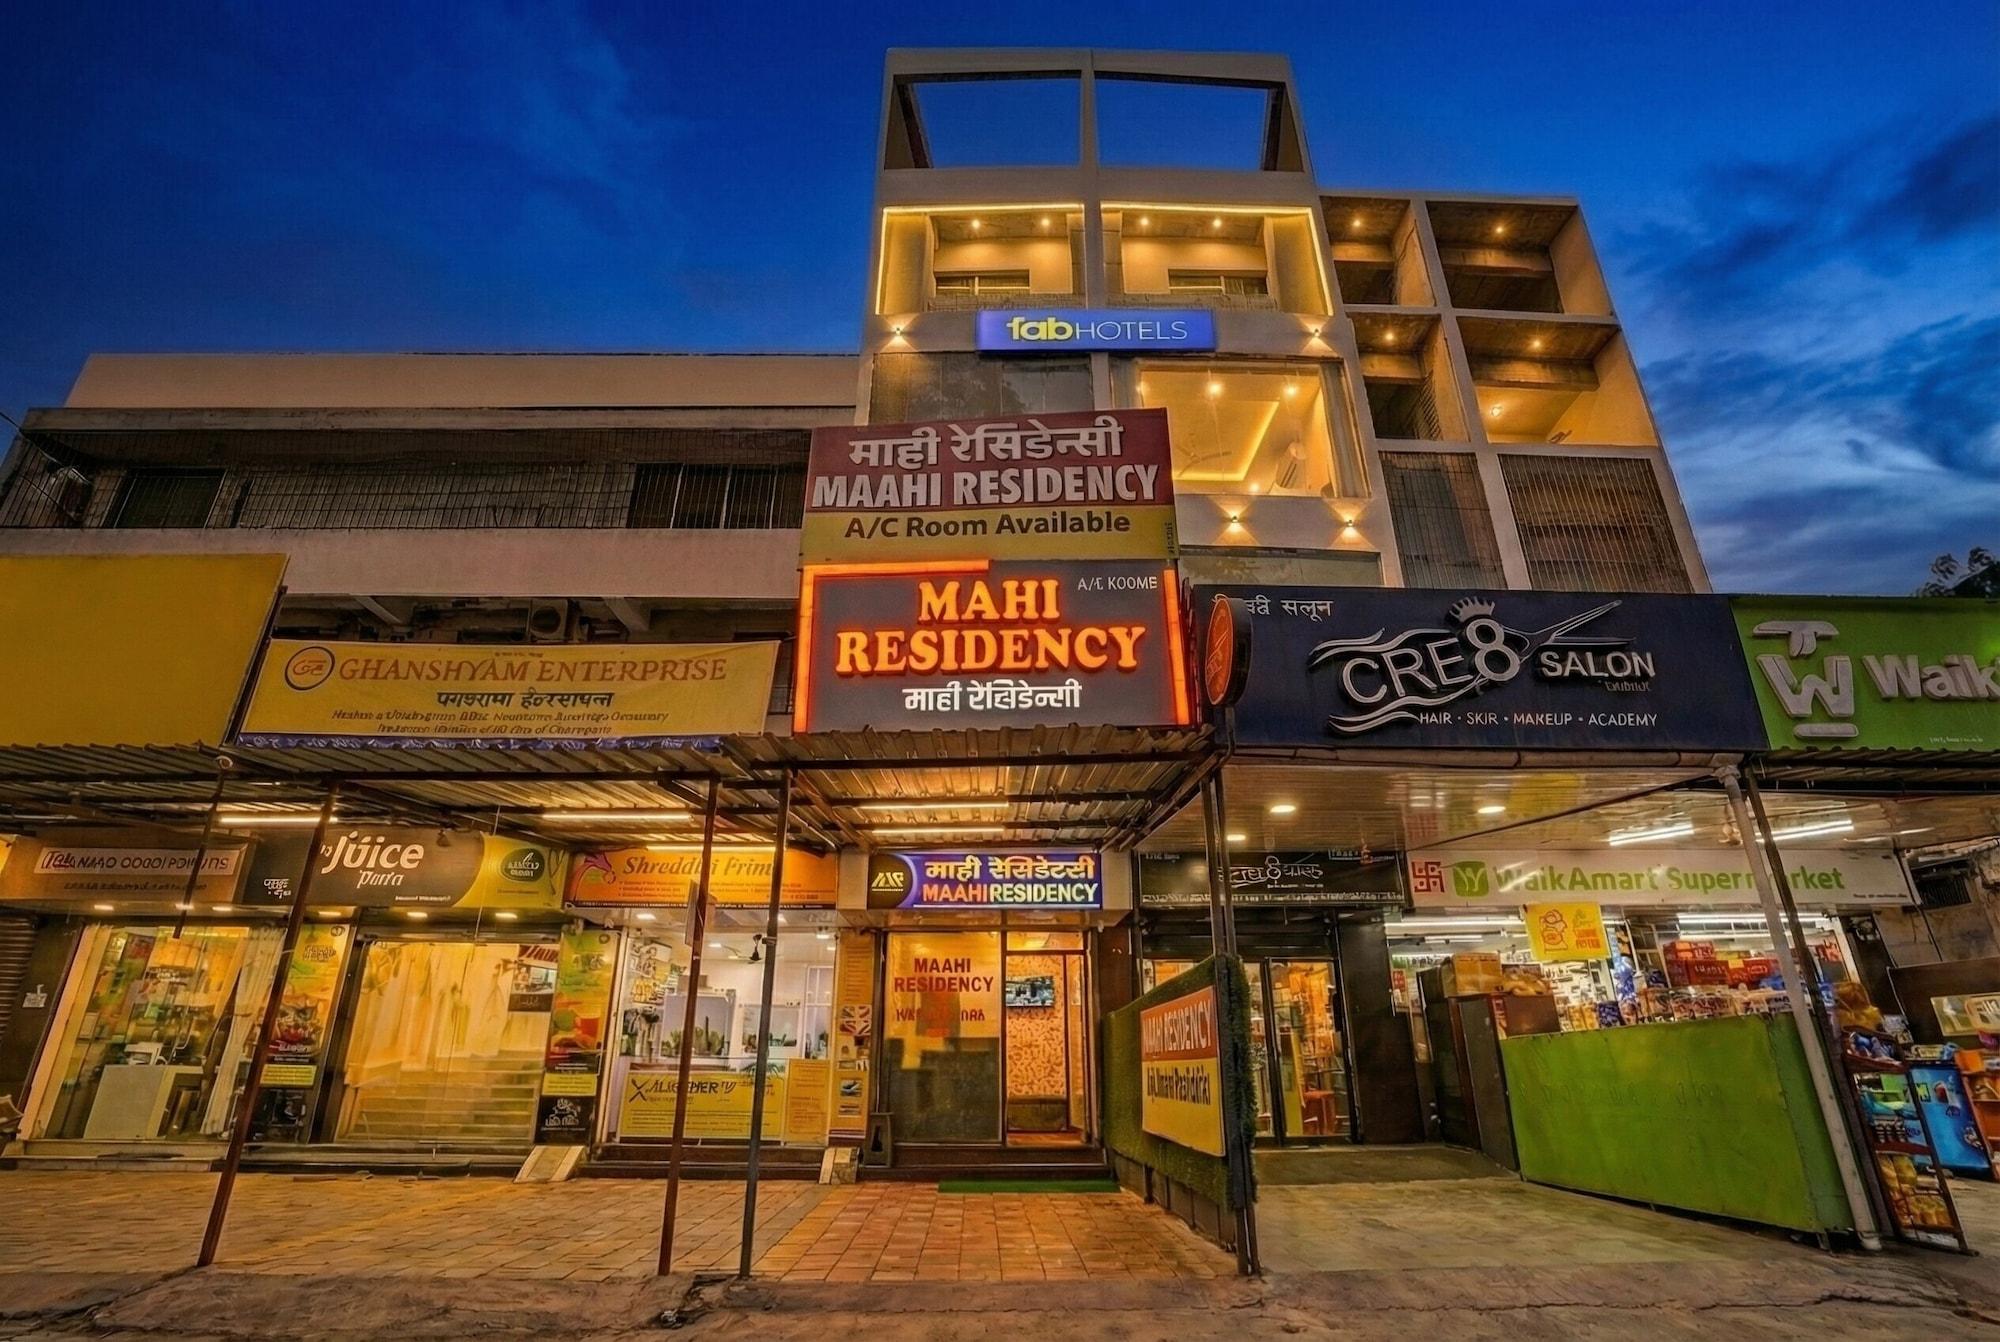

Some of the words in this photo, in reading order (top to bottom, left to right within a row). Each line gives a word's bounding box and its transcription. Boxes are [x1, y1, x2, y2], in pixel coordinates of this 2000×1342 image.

[848, 426, 941, 470] माही
[948, 415, 1124, 463] रेसिडेन्सी
[811, 472, 941, 509] MAAHI
[953, 463, 1160, 506] RESIDENCY
[844, 517, 899, 539] A/C
[905, 514, 988, 538] Room
[995, 510, 1131, 535] Available
[918, 578, 1061, 625] MAHI
[1280, 600, 1335, 622] सलून
[835, 624, 1147, 678] RESIDENCY
[1538, 650, 1656, 679] SALON
[339, 656, 527, 682] GHANSHYAM
[536, 657, 728, 682] ENTERPRISE
[902, 680, 963, 712] माही
[1419, 712, 1453, 726] HAIR
[1513, 712, 1573, 727] MAKEUP
[1588, 712, 1658, 727] ACADEMY
[924, 854, 983, 882] माही
[922, 883, 988, 902] MAAHI
[989, 883, 1099, 903] RESIDENCY
[913, 958, 971, 973] MAAHI
[894, 976, 994, 993] RESIDENCY
[1164, 999, 1212, 1052] RESIDENCY
